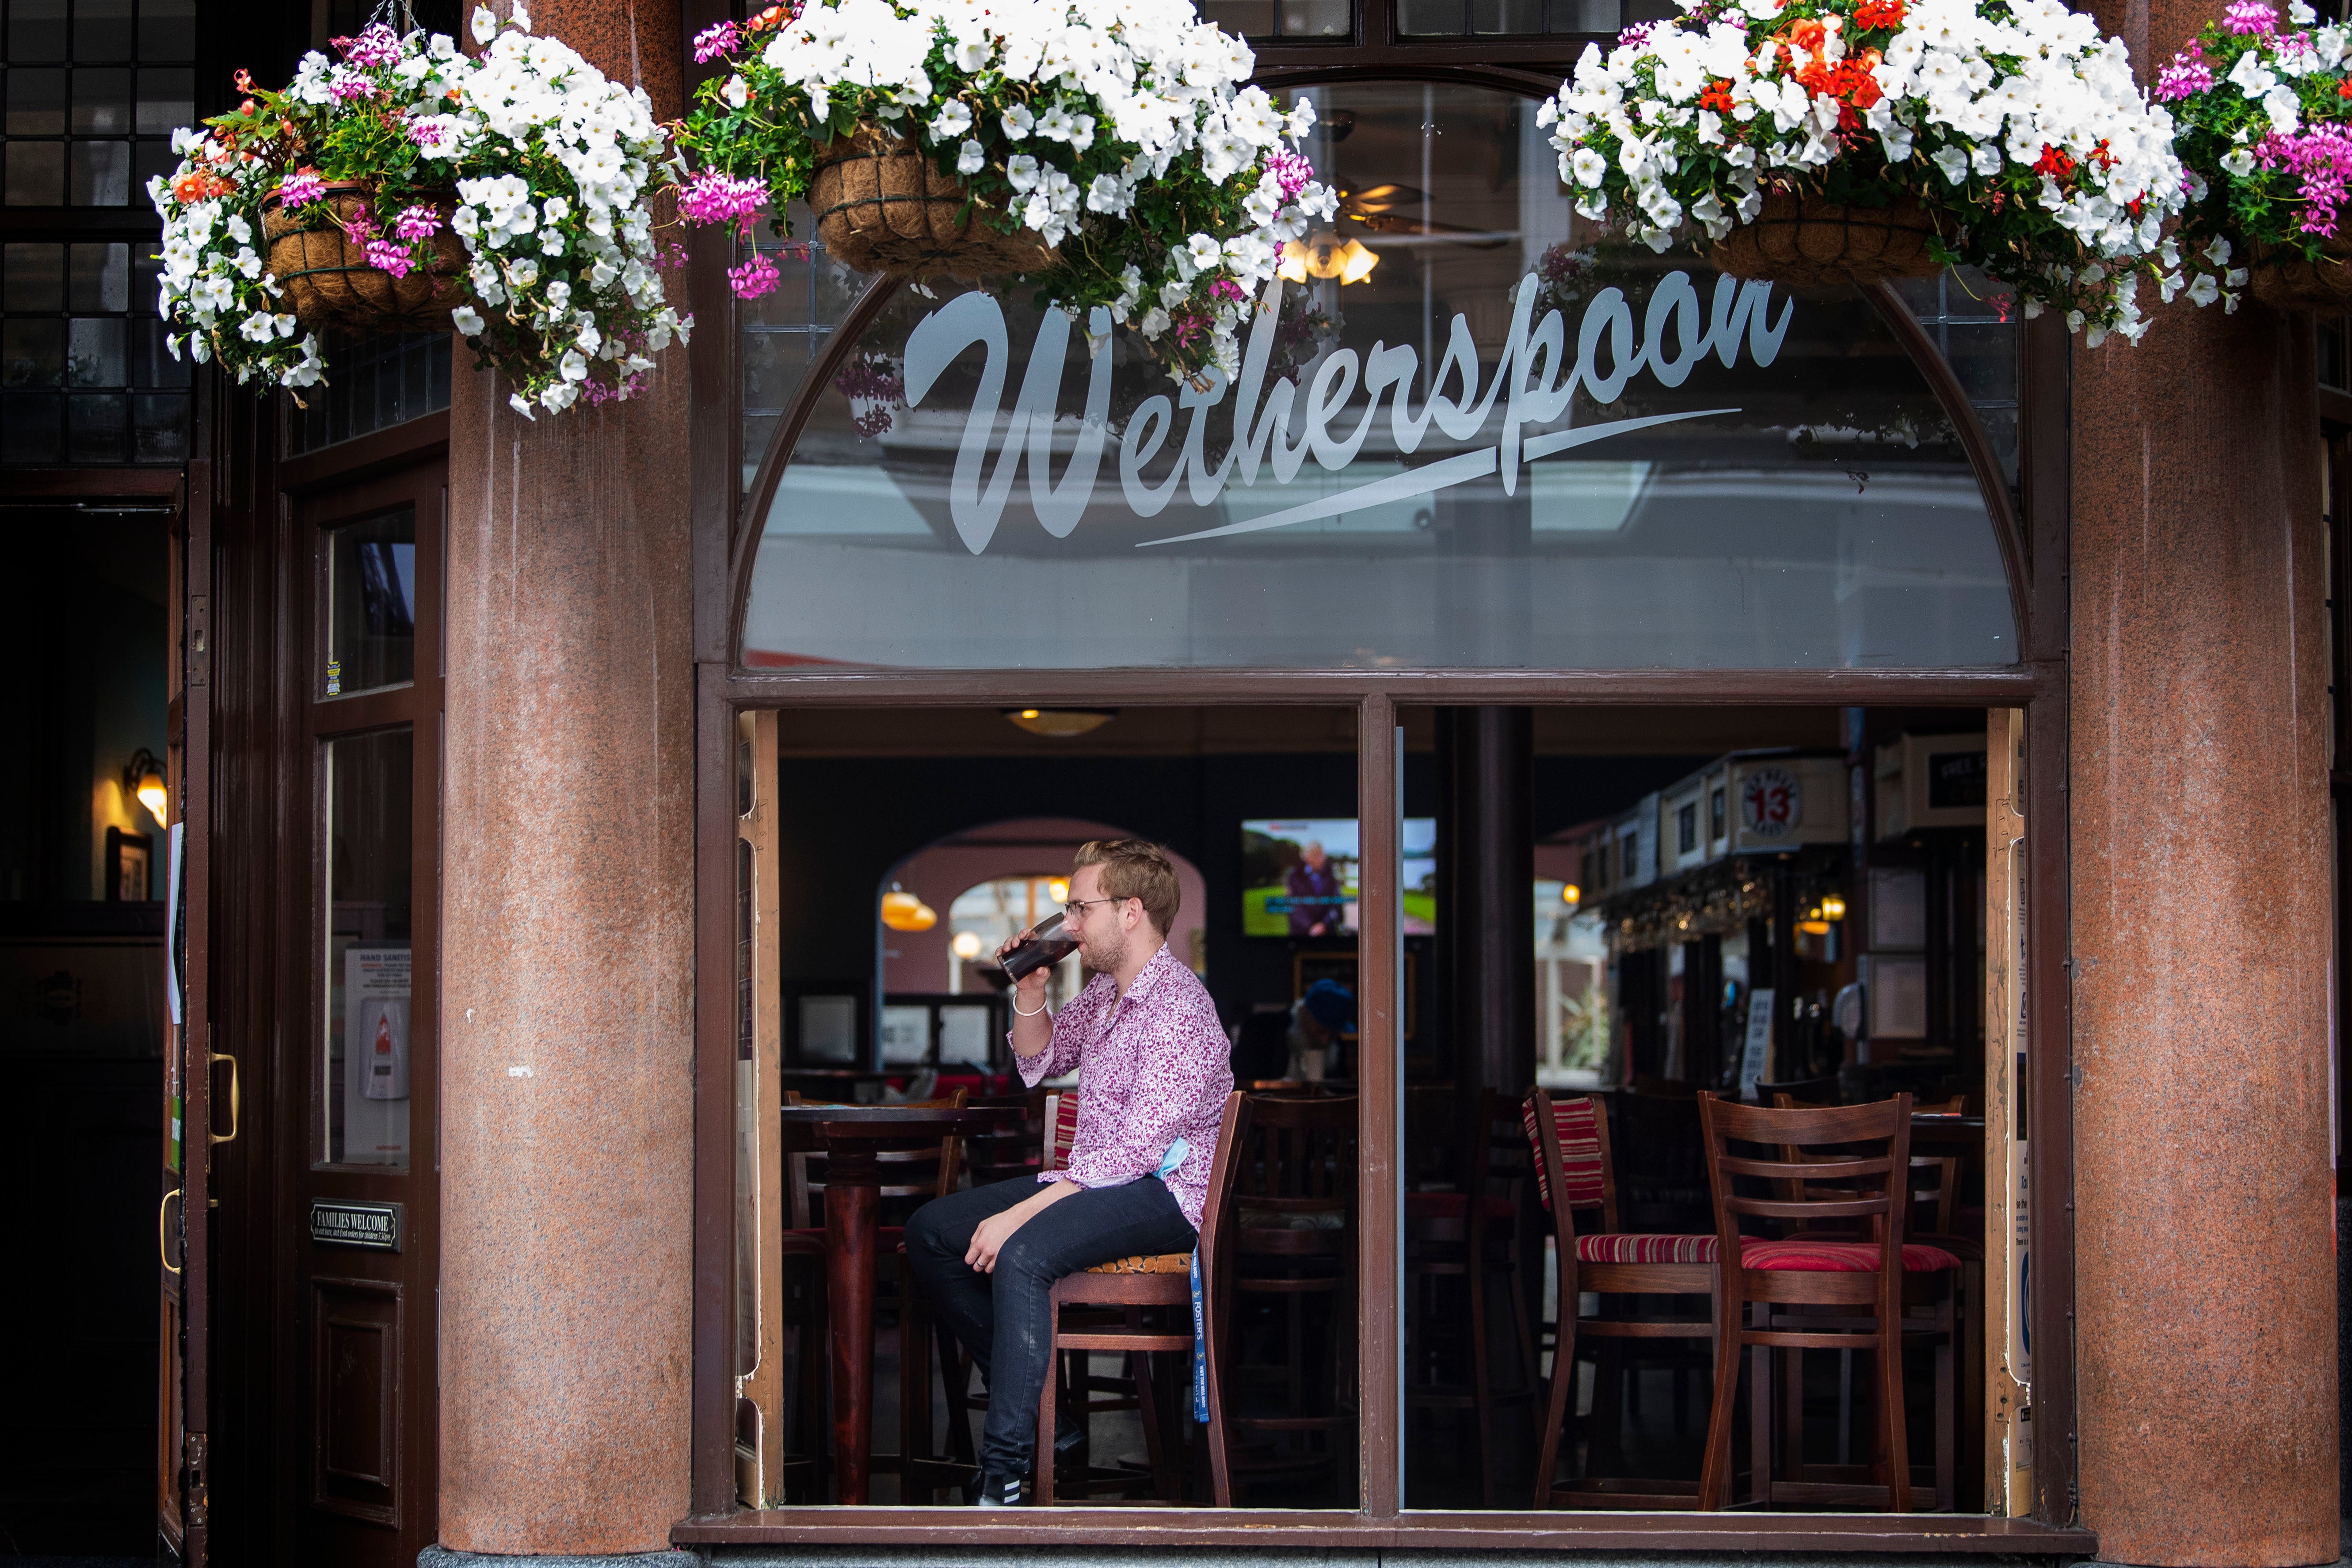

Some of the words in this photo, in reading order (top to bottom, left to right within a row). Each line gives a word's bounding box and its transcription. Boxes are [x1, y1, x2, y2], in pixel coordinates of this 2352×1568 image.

[904, 268, 1794, 556] Wetherspoon
[1751, 787, 1789, 821] 13
[317, 1211, 350, 1229] FAMILIES
[351, 1213, 389, 1232] WELCOME
[365, 1232, 378, 1240] children
[1194, 1301, 1202, 1340] FOSTER'S
